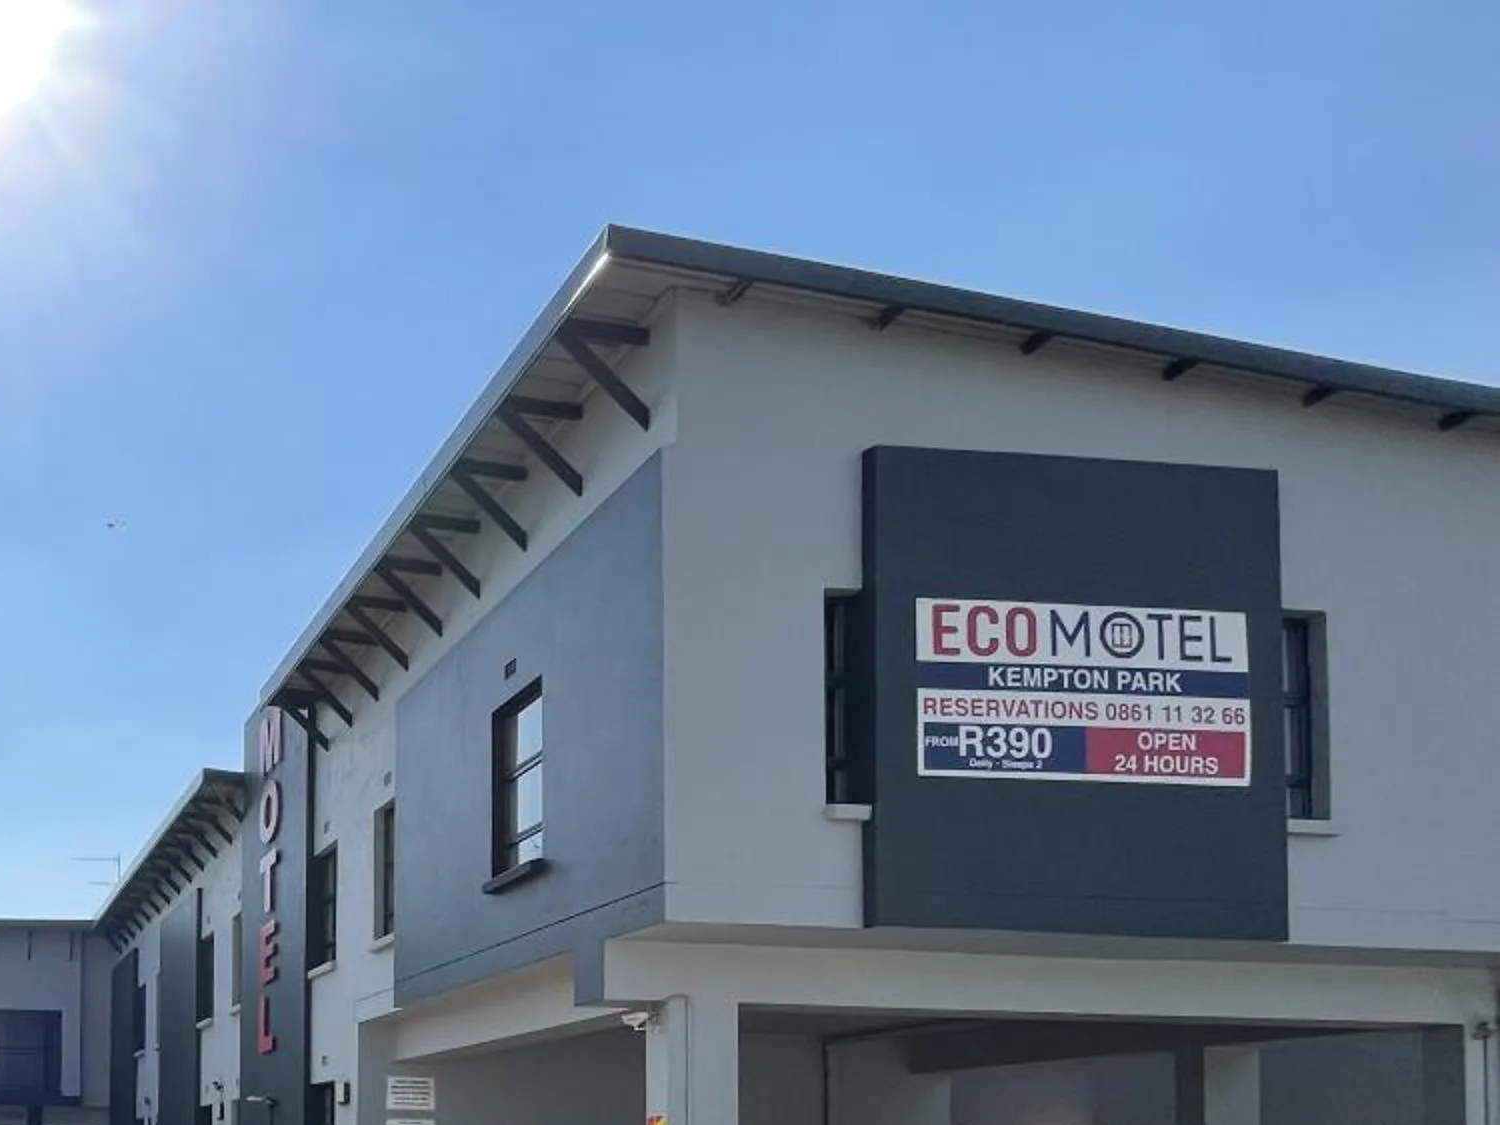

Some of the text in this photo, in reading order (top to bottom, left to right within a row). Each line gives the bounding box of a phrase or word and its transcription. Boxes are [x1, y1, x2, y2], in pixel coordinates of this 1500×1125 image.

[988, 667, 1183, 693] KEMPTON PARK
[923, 697, 1246, 725] RESERVATIONS 0861 11 32 66
[925, 725, 1053, 759] FROM R390
[1137, 731, 1197, 751] OPEN
[1114, 754, 1219, 775] 24 HOURS
[257, 705, 283, 1055] MOTEL
